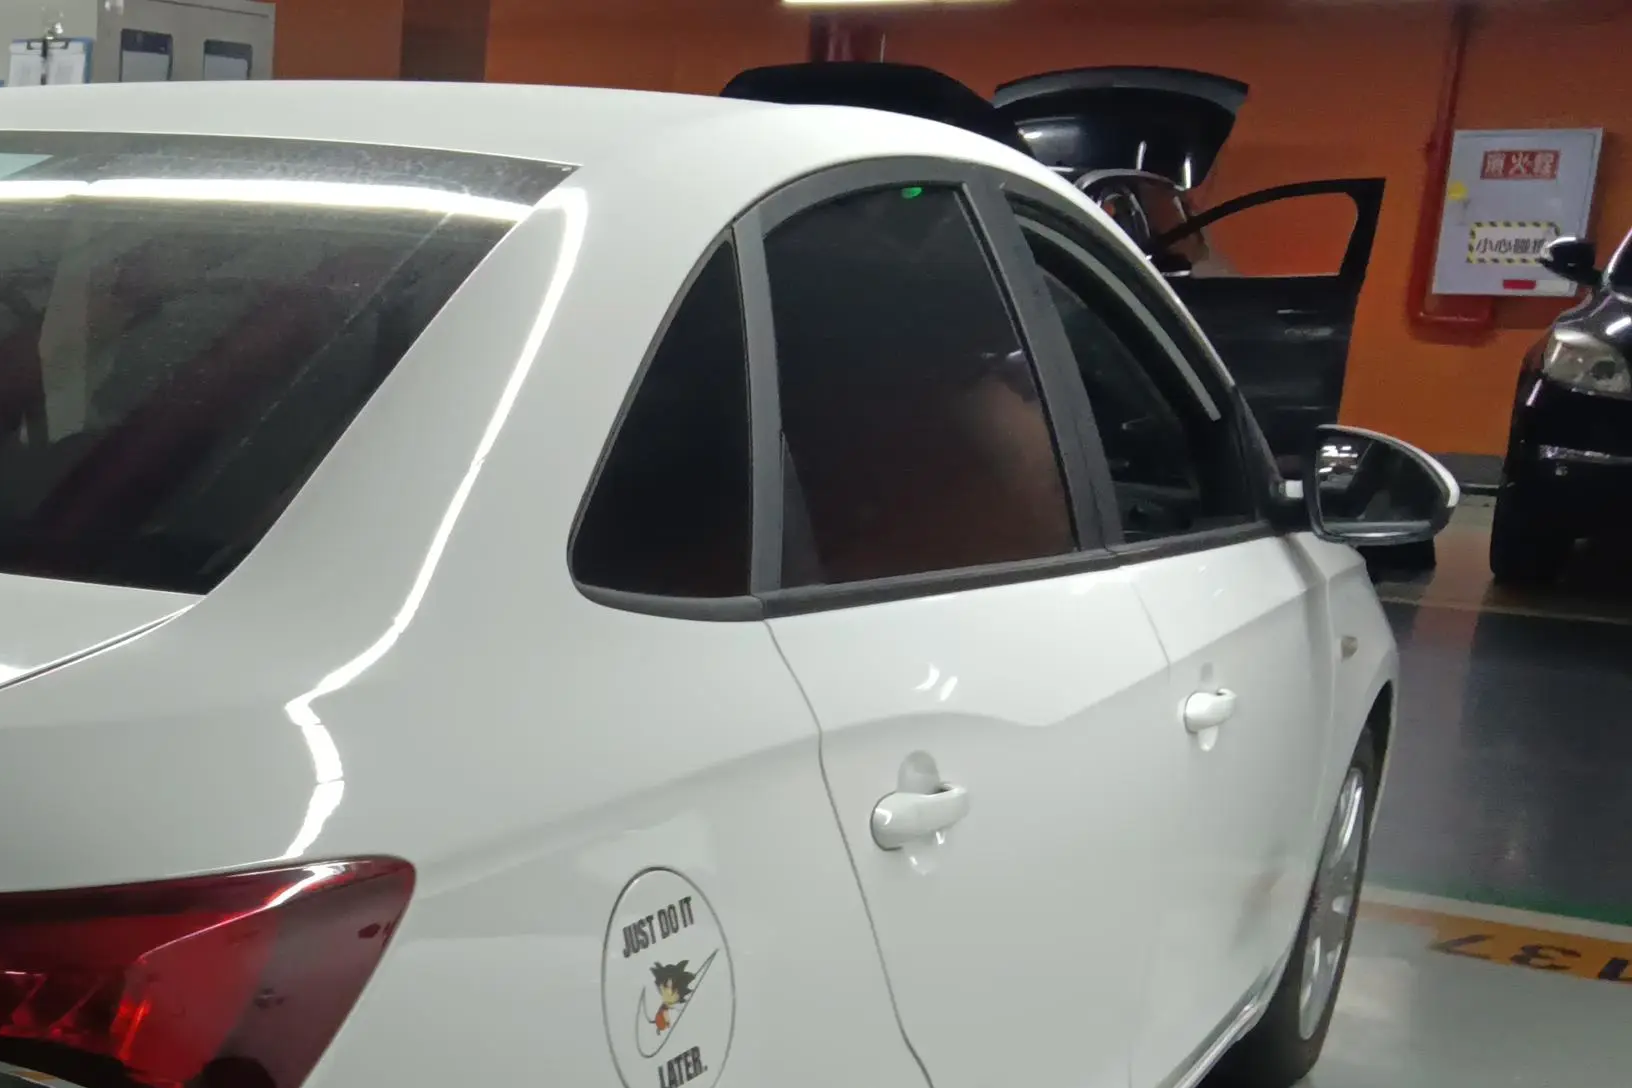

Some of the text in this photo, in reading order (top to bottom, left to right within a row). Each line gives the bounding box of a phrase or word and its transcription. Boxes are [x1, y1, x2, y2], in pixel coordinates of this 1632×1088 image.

[622, 896, 694, 958] JUST DO IT
